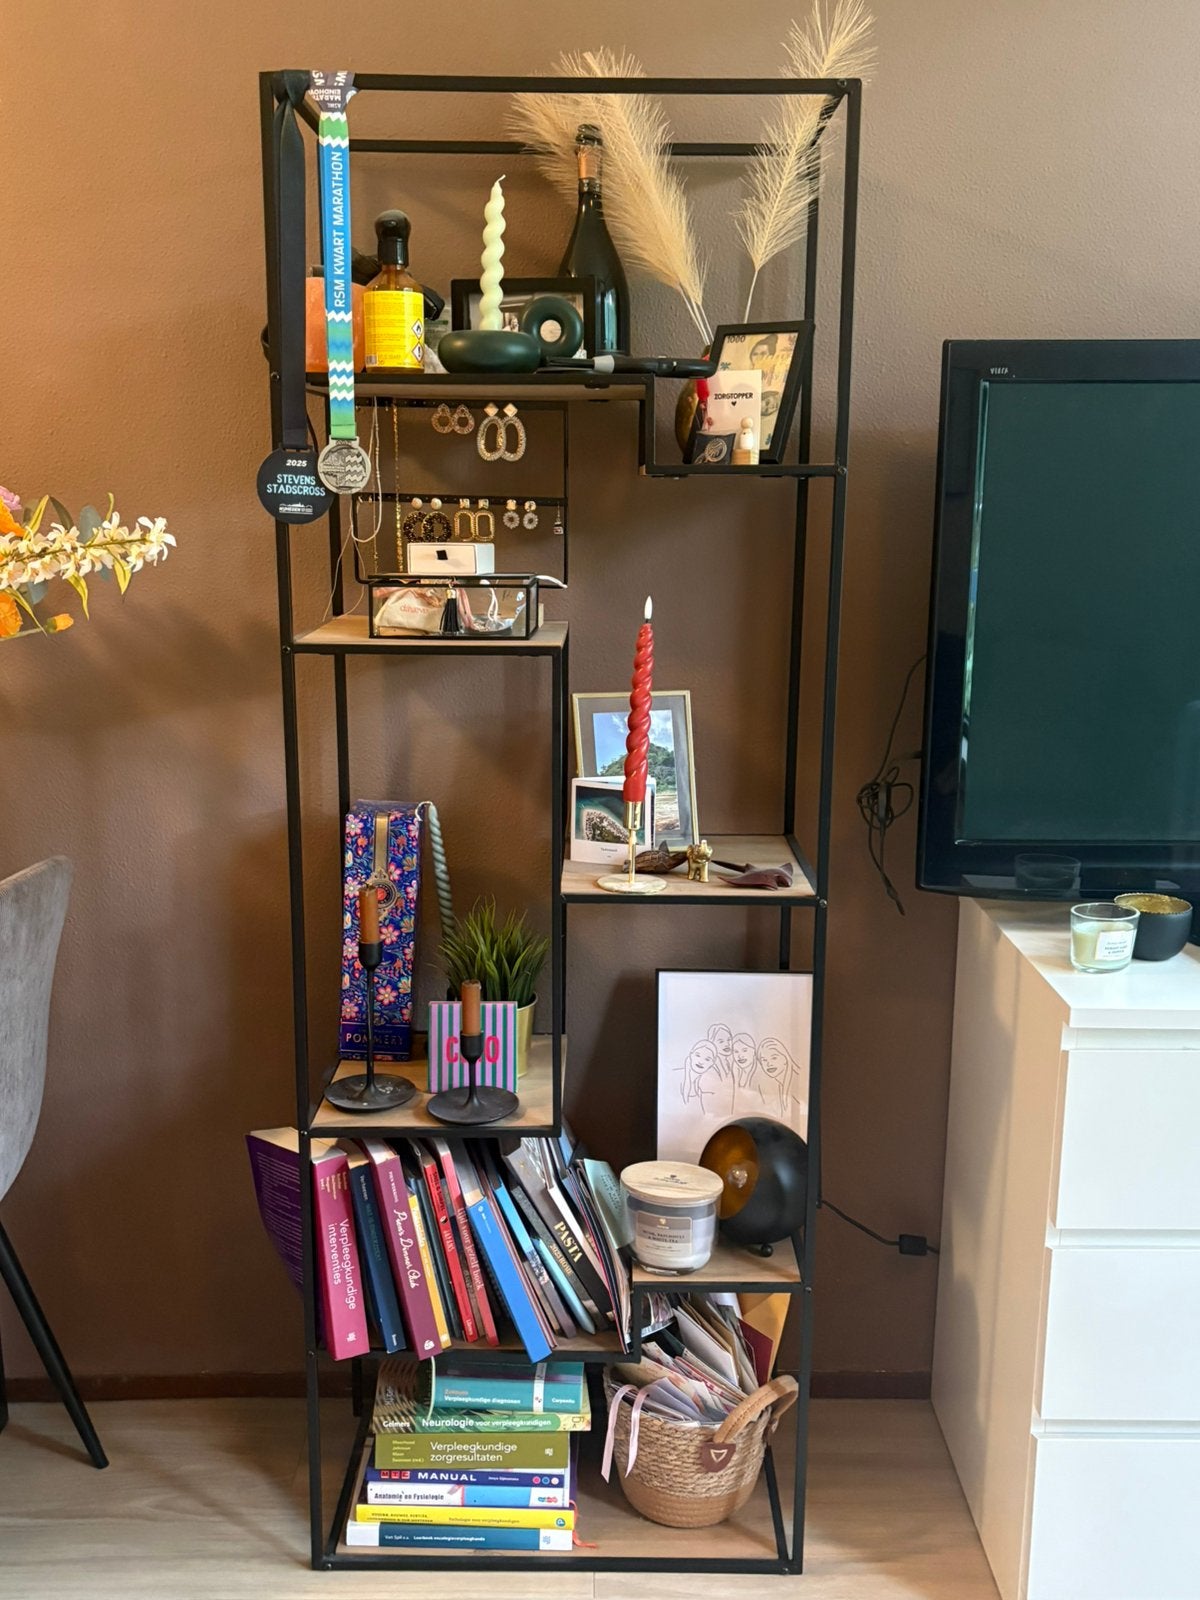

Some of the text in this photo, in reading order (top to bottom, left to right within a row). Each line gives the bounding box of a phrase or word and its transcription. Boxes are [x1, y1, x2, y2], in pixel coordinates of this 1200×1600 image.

[331, 151, 345, 307] RSM KWART MARATHON
[714, 392, 753, 400] ZORGTOPPER
[286, 459, 307, 467] 2025
[276, 474, 316, 486] STEVENS
[266, 484, 326, 497] STADSCROSS
[446, 1035, 500, 1063] CO
[553, 1221, 583, 1263] PASTA
[328, 1223, 342, 1285] interventies
[339, 1218, 358, 1310] Verpleegkundige
[400, 1237, 414, 1269] Dinner
[407, 1269, 421, 1289] Club
[473, 1270, 484, 1291] boek
[422, 1417, 474, 1428] Neurologie
[491, 1419, 552, 1428] verpleegkundigen
[430, 1441, 518, 1454] Verpleegkundige
[430, 1453, 503, 1464] zorgresultaten
[417, 1472, 477, 1482] MANUAL
[374, 1492, 403, 1500] Anatomie
[413, 1493, 444, 1502] Fysiologie
